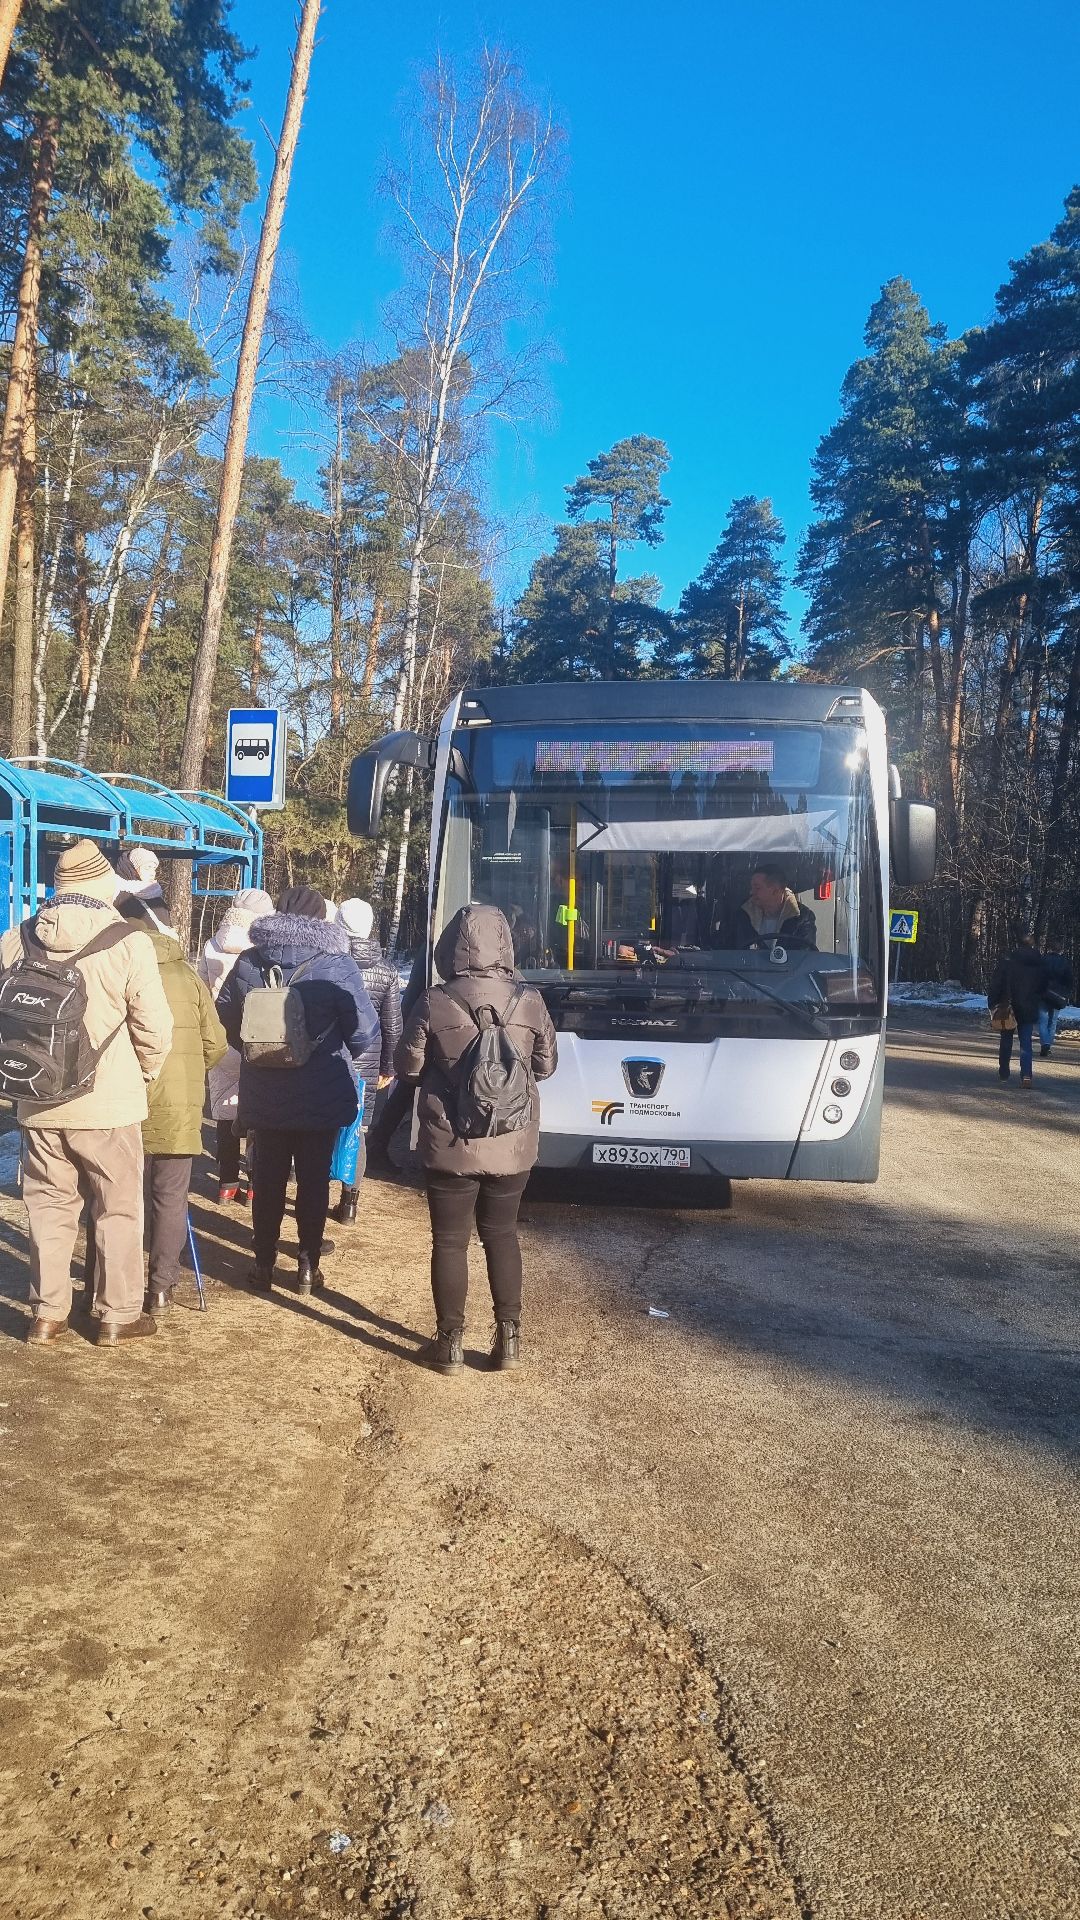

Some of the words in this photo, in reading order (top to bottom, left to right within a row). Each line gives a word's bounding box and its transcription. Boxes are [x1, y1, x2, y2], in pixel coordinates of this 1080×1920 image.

[629, 1102, 670, 1110] ТРАНСПОРТ
[629, 1109, 681, 1118] ПОДМОСКОВЬЯ
[662, 1148, 686, 1161] 790
